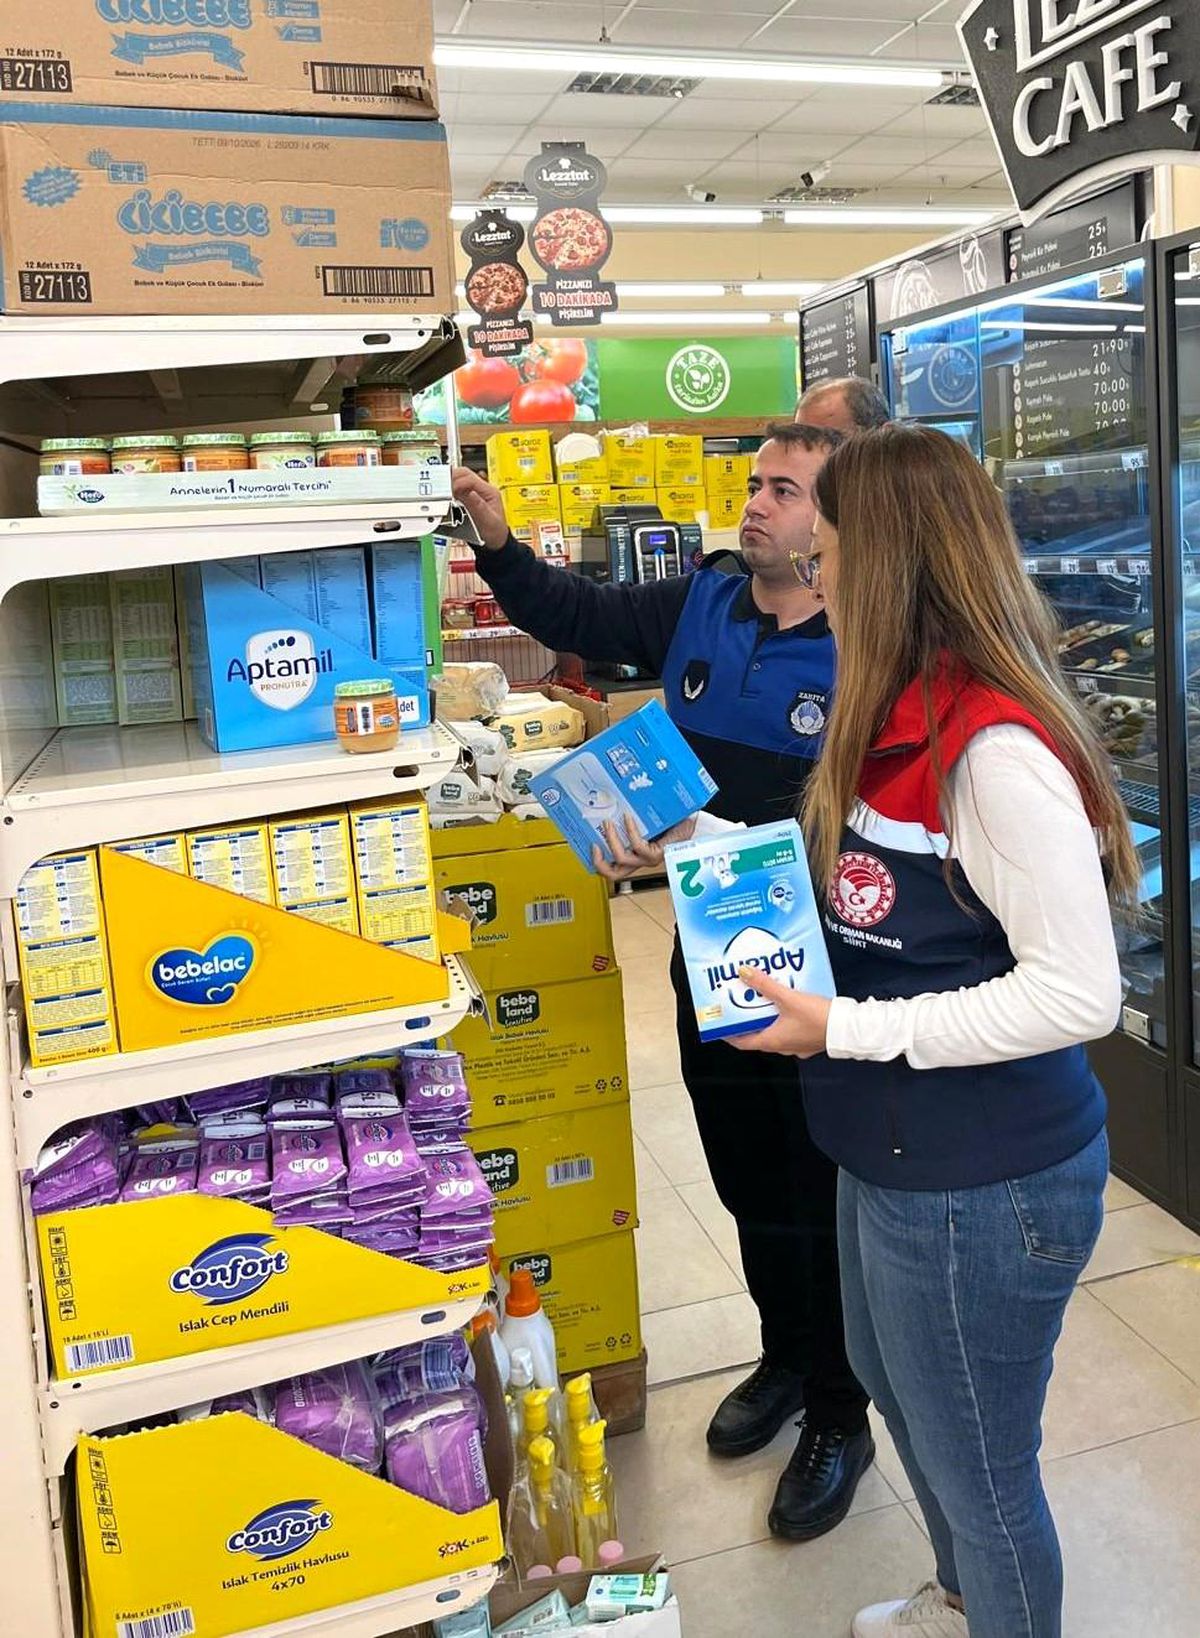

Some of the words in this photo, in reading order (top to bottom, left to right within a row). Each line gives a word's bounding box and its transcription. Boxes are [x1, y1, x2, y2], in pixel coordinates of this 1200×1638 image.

[16, 48, 34, 58] Adet
[42, 49, 56, 59] 172
[15, 62, 68, 90] 27113
[1012, 16, 1182, 157] CAFE
[25, 261, 35, 269] 12
[36, 261, 54, 270] Adet
[61, 262, 74, 270] 172
[34, 273, 88, 301] 27113
[169, 484, 227, 497] Annelerin
[228, 479, 236, 494] 1
[238, 481, 291, 494] Numaralı
[226, 648, 333, 686] Aptamil
[674, 857, 706, 898] 2
[839, 925, 867, 940] ORMAN
[865, 932, 903, 950] BAKANLIĞI
[159, 955, 247, 983] bebelac
[499, 993, 538, 1009] bebe
[505, 1004, 534, 1017] land
[479, 1150, 516, 1170] ebe
[170, 1251, 289, 1294] Confort
[513, 1256, 549, 1274] bebe
[178, 1318, 209, 1334] Islak
[210, 1313, 238, 1332] Cep
[239, 1300, 290, 1323] Mendili
[226, 1511, 334, 1556] Confort
[221, 1575, 250, 1591] Islak
[250, 1561, 302, 1584] Temizlik
[302, 1547, 350, 1573] Havlusu
[270, 1573, 306, 1592] 4x70
